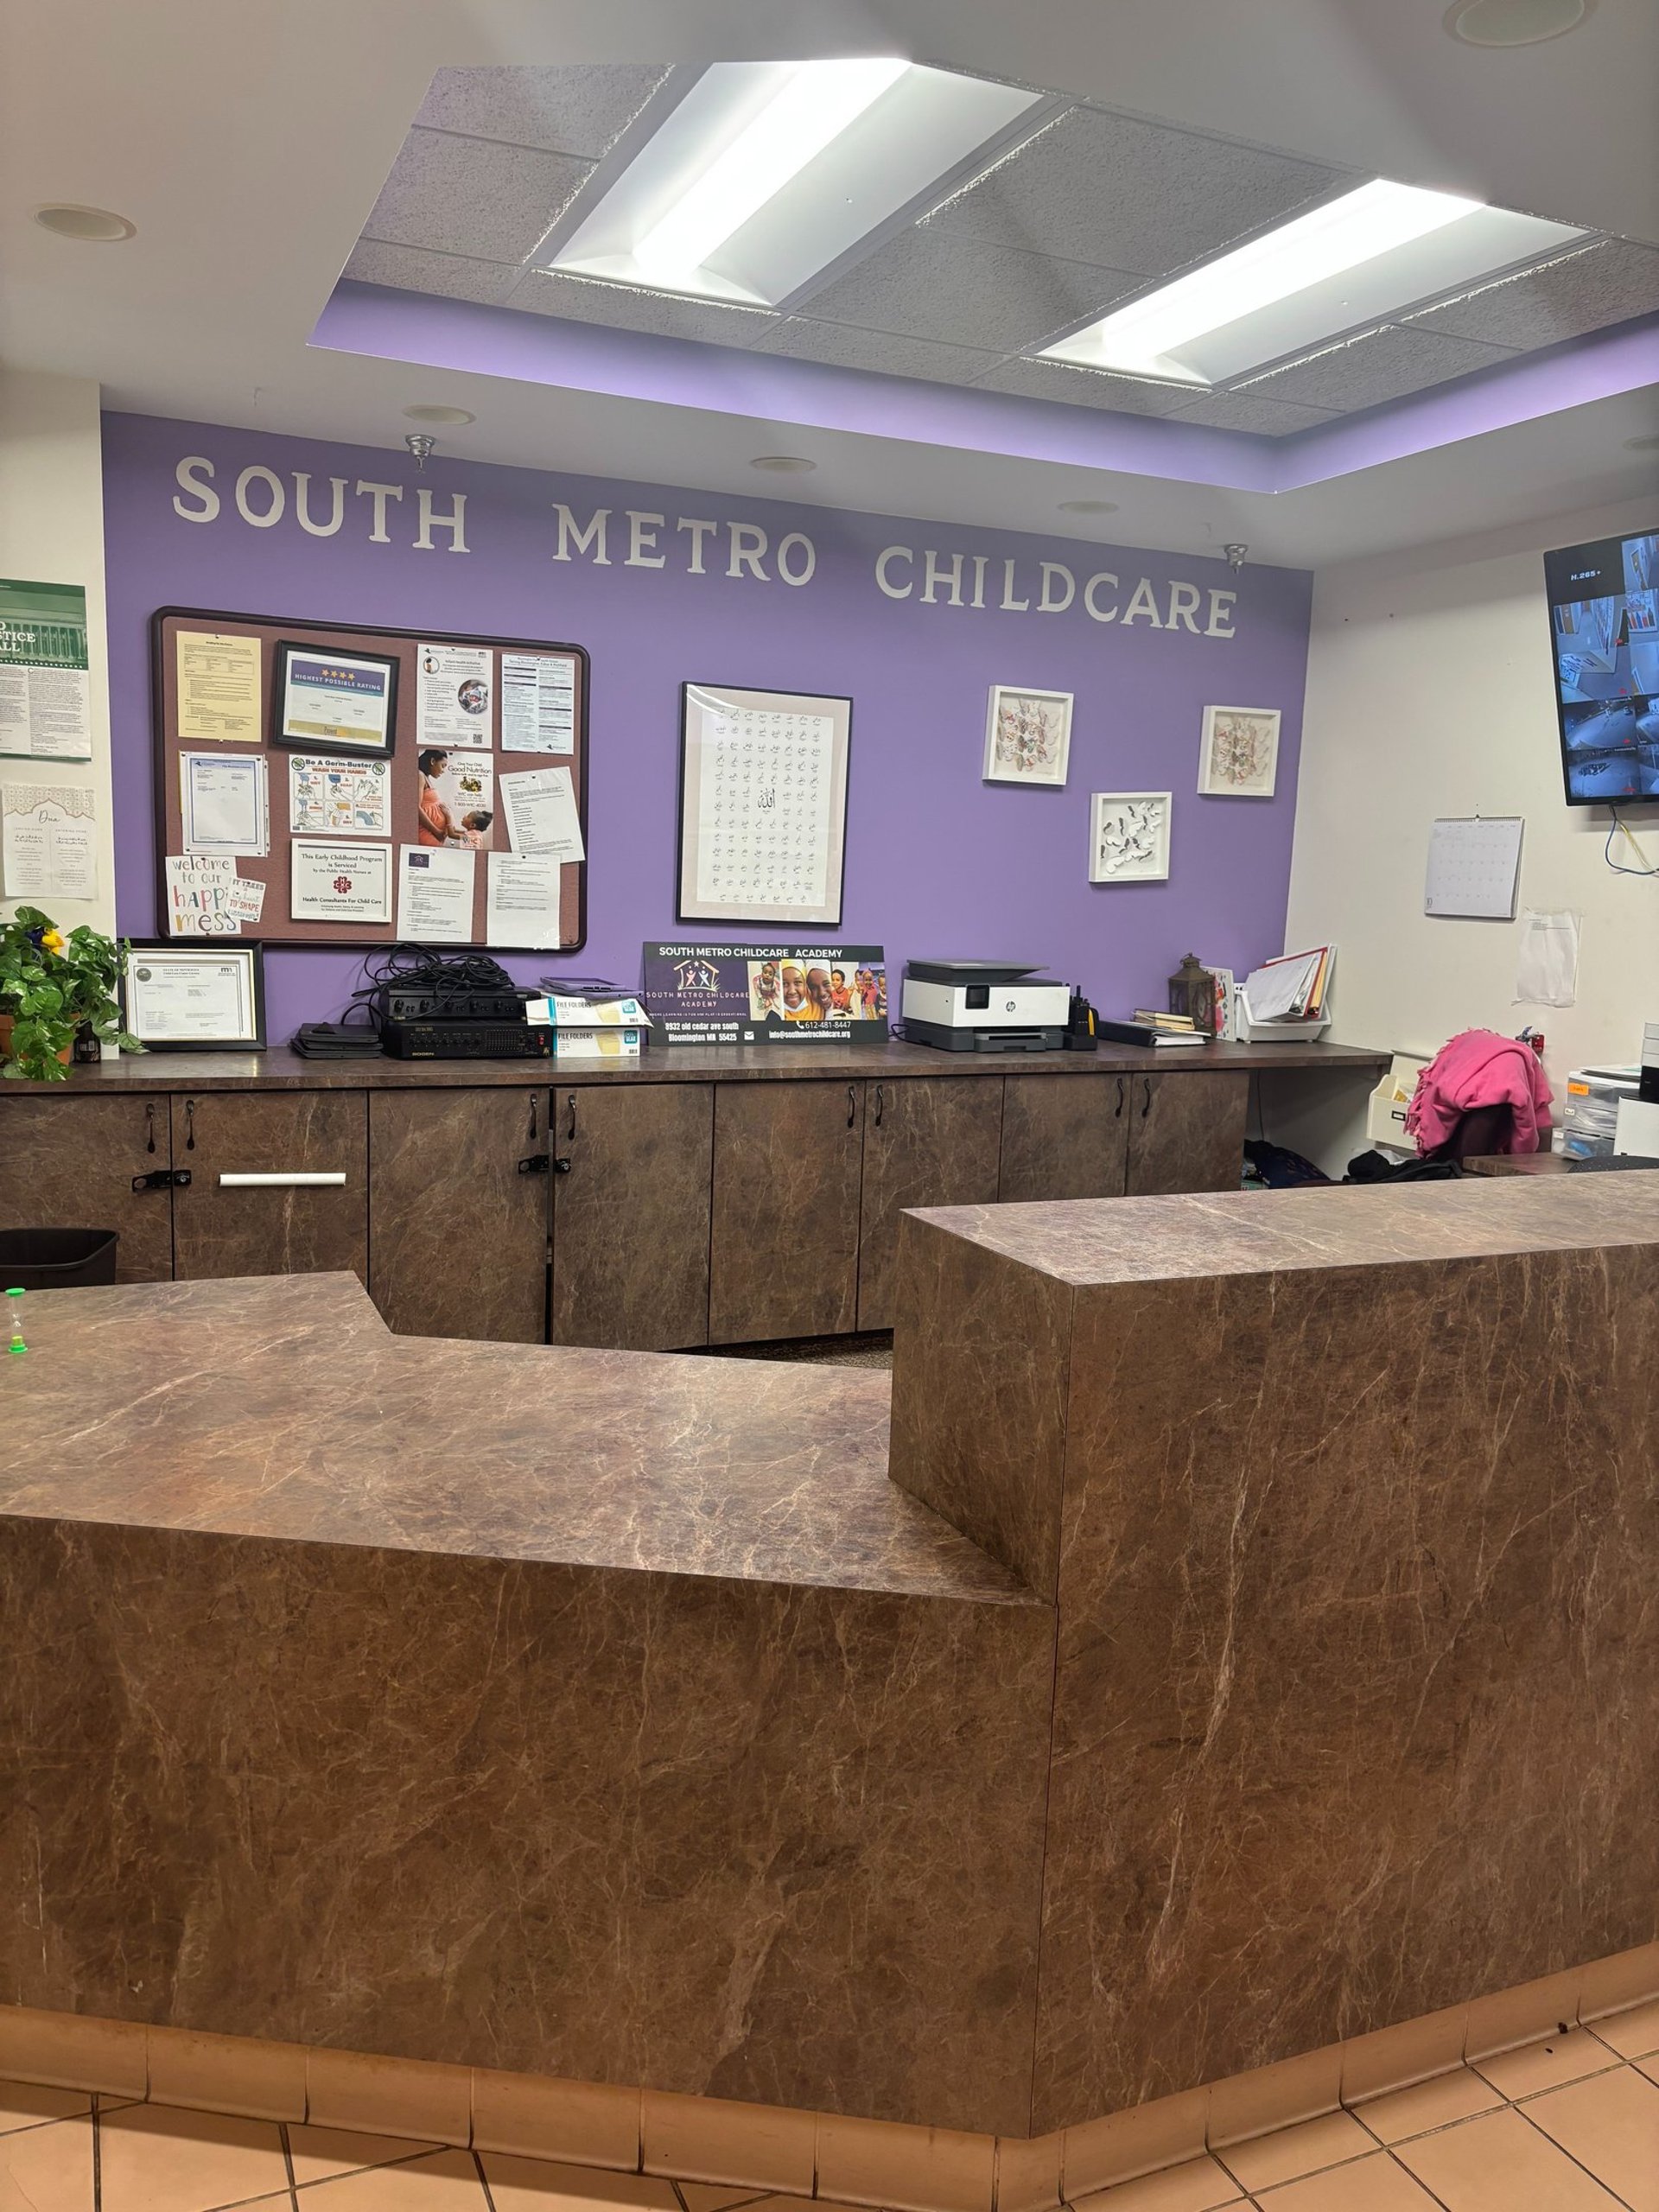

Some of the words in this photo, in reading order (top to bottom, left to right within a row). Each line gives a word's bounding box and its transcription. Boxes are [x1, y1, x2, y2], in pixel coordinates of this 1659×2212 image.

[173, 456, 471, 553] SOUTH
[552, 503, 816, 586] METRO
[875, 545, 1237, 639] CHILDCARE
[1570, 570, 1601, 581] H.265+
[295, 673, 323, 682] HIGHEST
[325, 677, 355, 687] POSSIBLE
[357, 682, 381, 690] RATING
[172, 855, 230, 870] welcome
[182, 872, 195, 884] to
[200, 873, 221, 884] our
[239, 901, 260, 912] SHAPE
[175, 912, 237, 931] mess
[658, 947, 694, 956] SOUTH
[696, 947, 732, 957] METRO
[734, 948, 789, 957] CHILDCARE
[795, 949, 842, 957] ACADEMY
[668, 1033, 706, 1042] Bloomington
